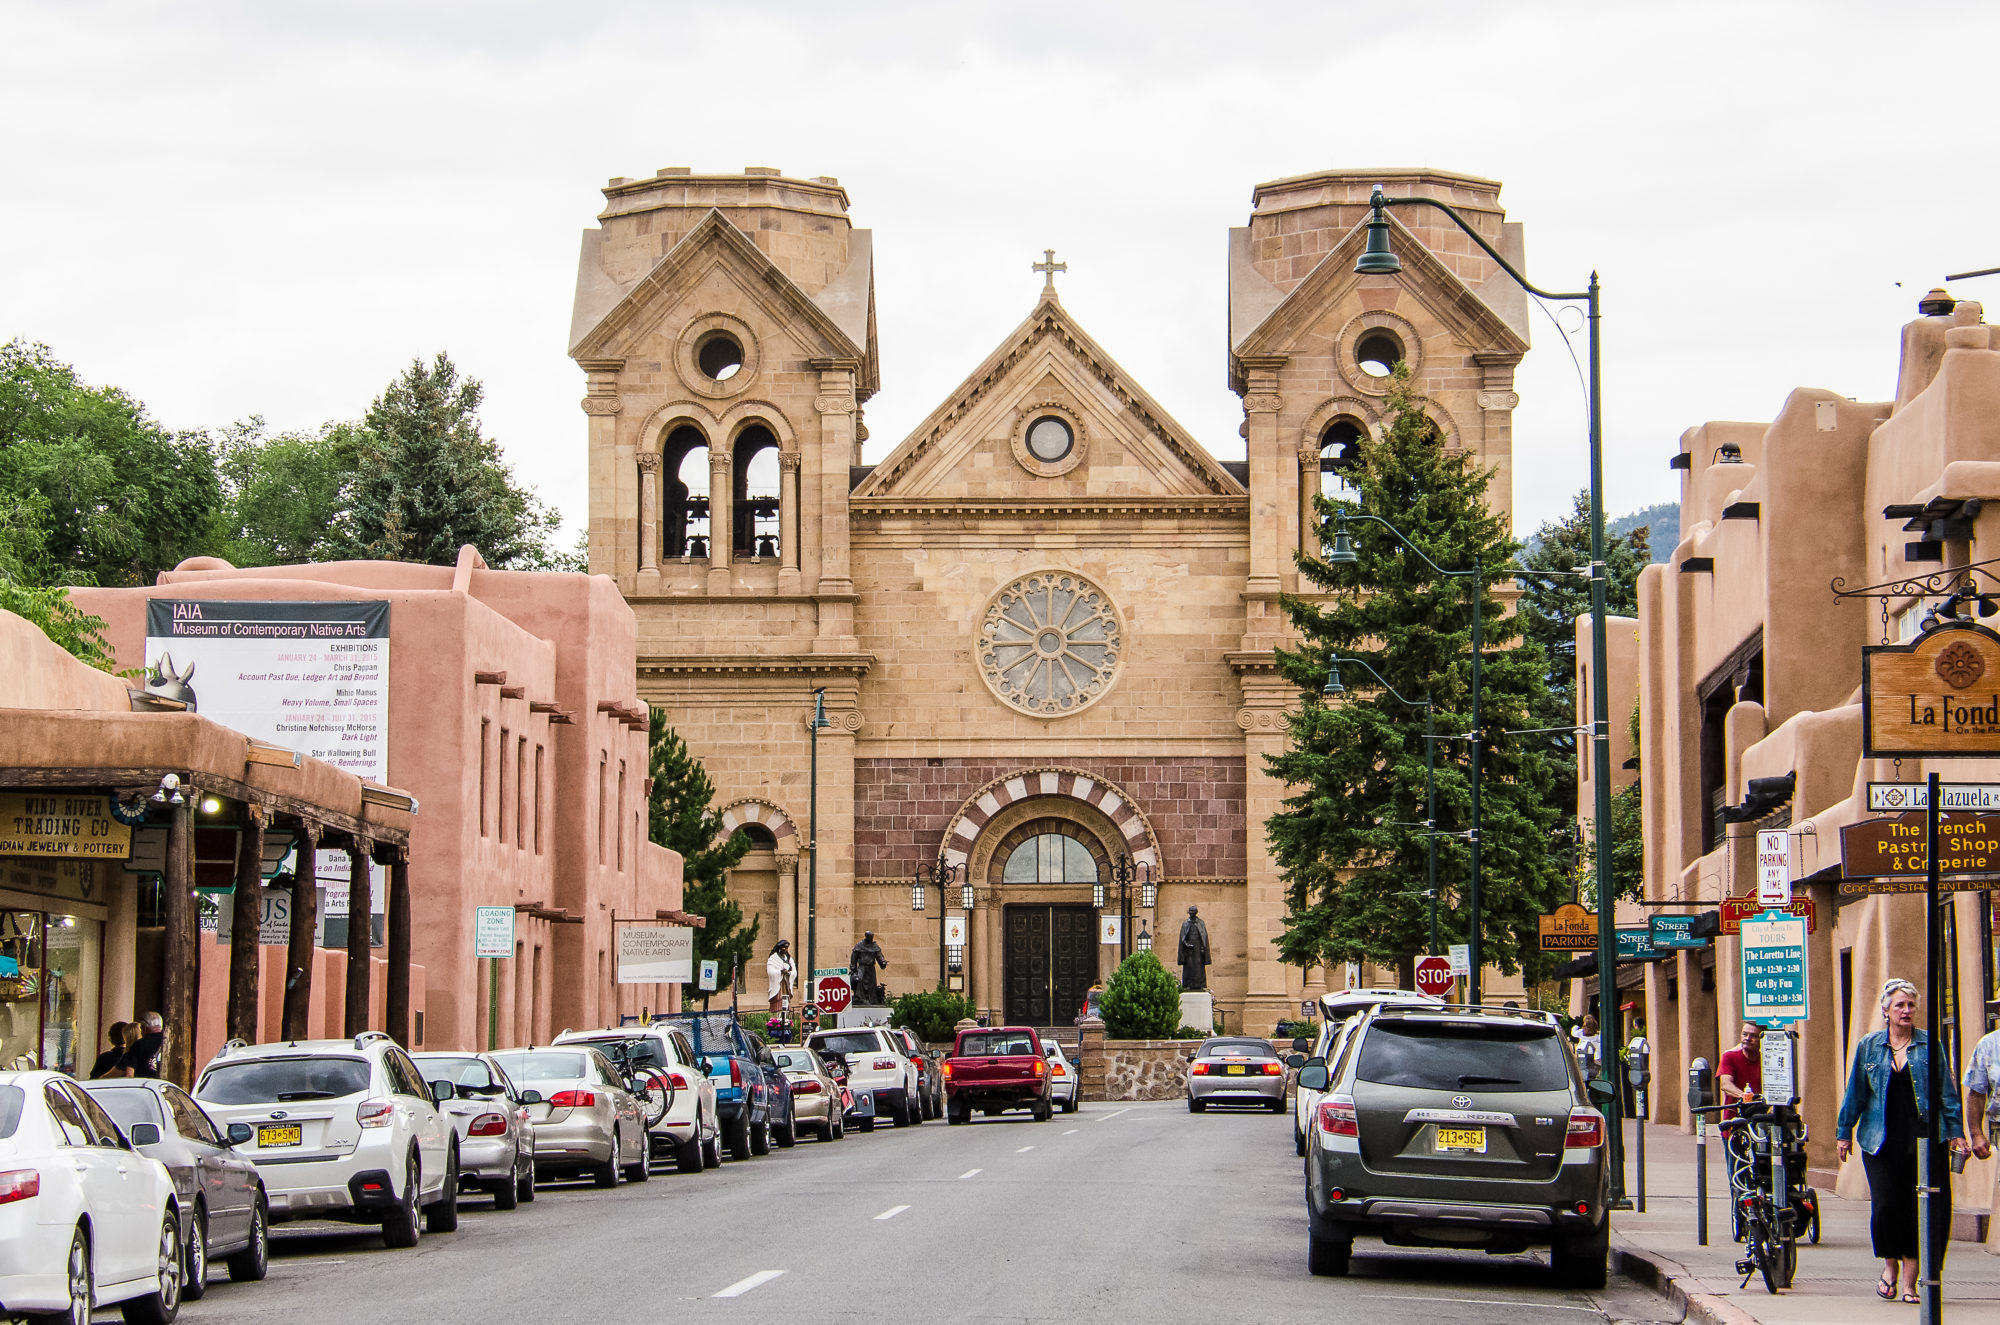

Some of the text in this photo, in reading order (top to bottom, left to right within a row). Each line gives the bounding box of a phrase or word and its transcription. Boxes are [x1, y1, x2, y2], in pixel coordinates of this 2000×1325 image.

[173, 603, 202, 619] IAIA
[173, 623, 366, 638] Museum of Contemporary Native Arts
[330, 644, 378, 652] EXHIBITIONS
[362, 653, 378, 661] 2015
[333, 664, 378, 672] Chris Pappan
[239, 673, 267, 681] Account
[268, 673, 284, 681] Past
[302, 673, 326, 682] Ledger
[328, 673, 338, 681] Art
[339, 673, 352, 681] and
[354, 673, 379, 681] Beyond
[282, 699, 303, 707] Heavy
[305, 699, 331, 707] Volume,
[353, 699, 377, 707] Spaces
[285, 714, 314, 722] JANUARY
[316, 714, 325, 722] 24
[332, 714, 345, 722] JULY
[1909, 693, 2000, 732] La Fond
[276, 724, 307, 732] Christine
[1972, 726, 1985, 734] the
[1988, 726, 2000, 734] Pla
[341, 733, 377, 742] Dark Light
[327, 749, 360, 758] Wallowing
[363, 749, 377, 757] Bull
[338, 759, 377, 768] Renderings
[1913, 787, 1928, 806] La
[1942, 787, 1990, 806] lazuela
[25, 798, 102, 817] WIND RIVER
[13, 818, 109, 837] TRADING CO
[1888, 820, 1986, 837] The rench
[0, 841, 124, 854] NDIAN JEWELRY & POTTERY
[1767, 836, 1779, 851] NO
[1878, 837, 1998, 854] Pastr Shop
[328, 854, 346, 862] Dana
[1760, 853, 1787, 867] PARKING
[1893, 855, 1987, 872] & Crperie
[1767, 869, 1780, 878] ANY
[1766, 880, 1782, 890] TIME
[1882, 881, 1963, 893] RESTAUANT
[1731, 902, 1759, 915] TOM
[1553, 919, 1589, 933] La Fonda
[623, 931, 658, 939] MUSEUM
[1619, 933, 1650, 943] STREE
[1759, 934, 1786, 943] TOURS
[1545, 936, 1598, 946] PARKING
[1745, 949, 1801, 960] The Loretto Line
[1747, 964, 1800, 974] 10:30 12:30 2:30
[1418, 969, 1452, 983] STOP
[1755, 979, 1793, 990] 4x4 By Fun
[819, 988, 848, 1002] STOP
[1761, 994, 1774, 1003] 11:30
[1777, 994, 1788, 1003] 1:30
[260, 1130, 277, 1141] 673
[1438, 1131, 1483, 1144] 213 SGJ
